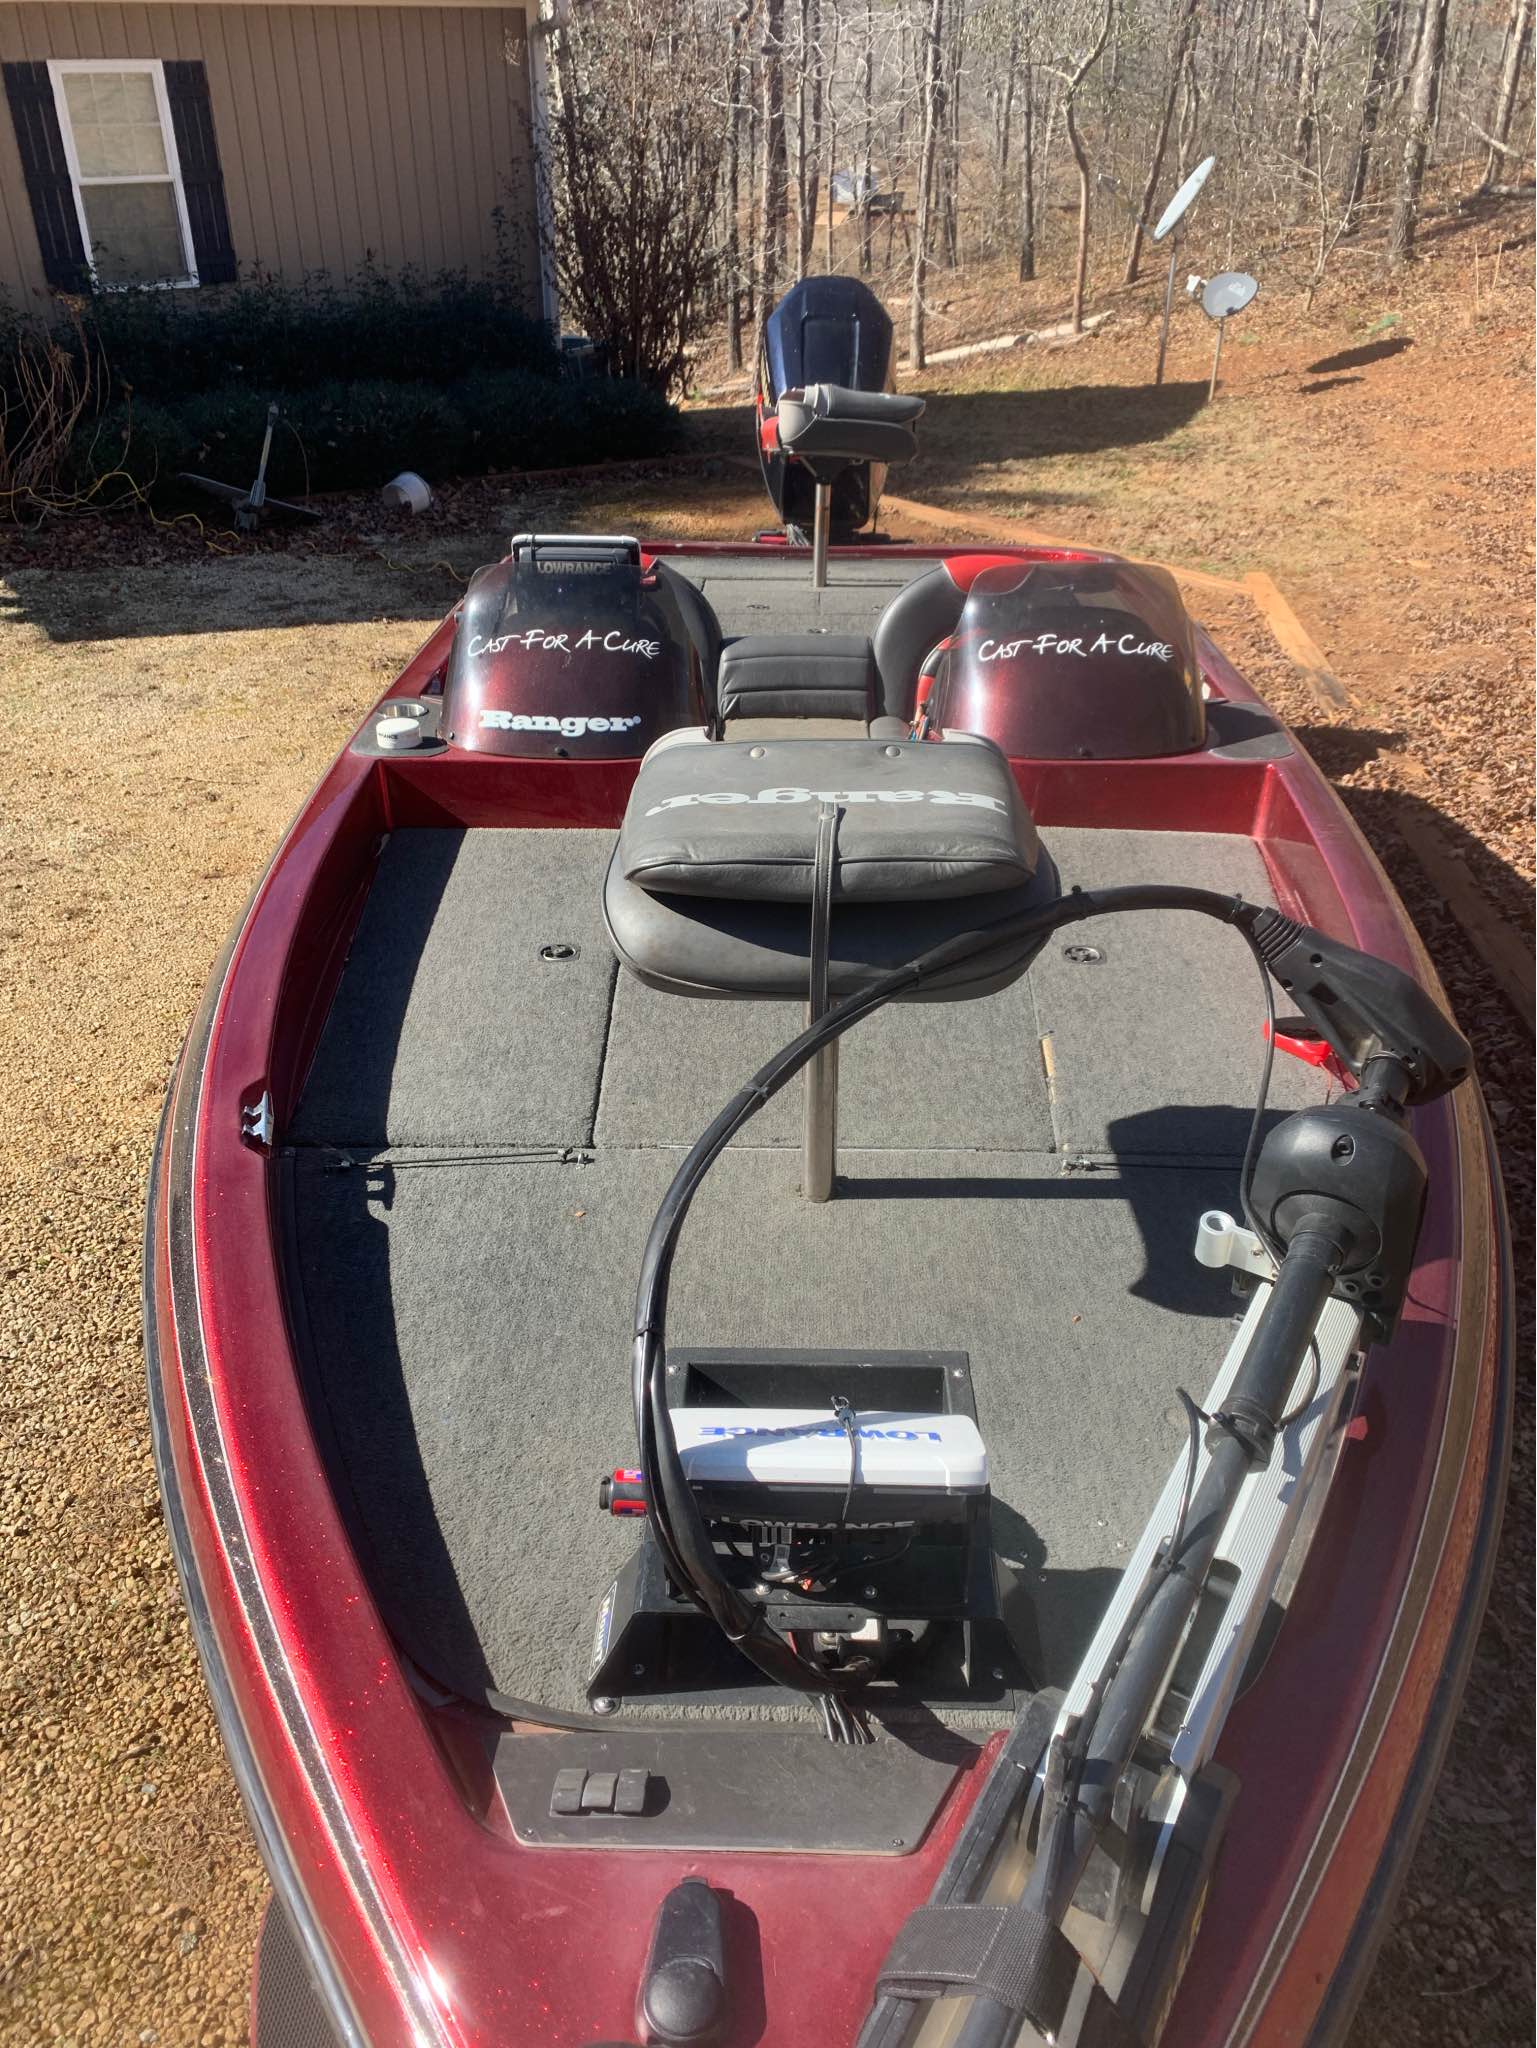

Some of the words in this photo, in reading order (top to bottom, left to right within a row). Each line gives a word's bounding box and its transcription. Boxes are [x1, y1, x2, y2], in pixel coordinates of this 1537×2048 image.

[536, 560, 612, 575] LOWRANCE
[467, 635, 521, 657] CAST
[520, 629, 571, 653] FOR
[575, 630, 602, 650] A
[604, 631, 661, 660] CURE
[978, 640, 1034, 662] CAST
[1032, 634, 1088, 657] FOR
[1090, 633, 1117, 653] A
[1118, 634, 1175, 662] CURE
[645, 787, 1008, 816] Ranger
[699, 1427, 942, 1443] LOWRANCE
